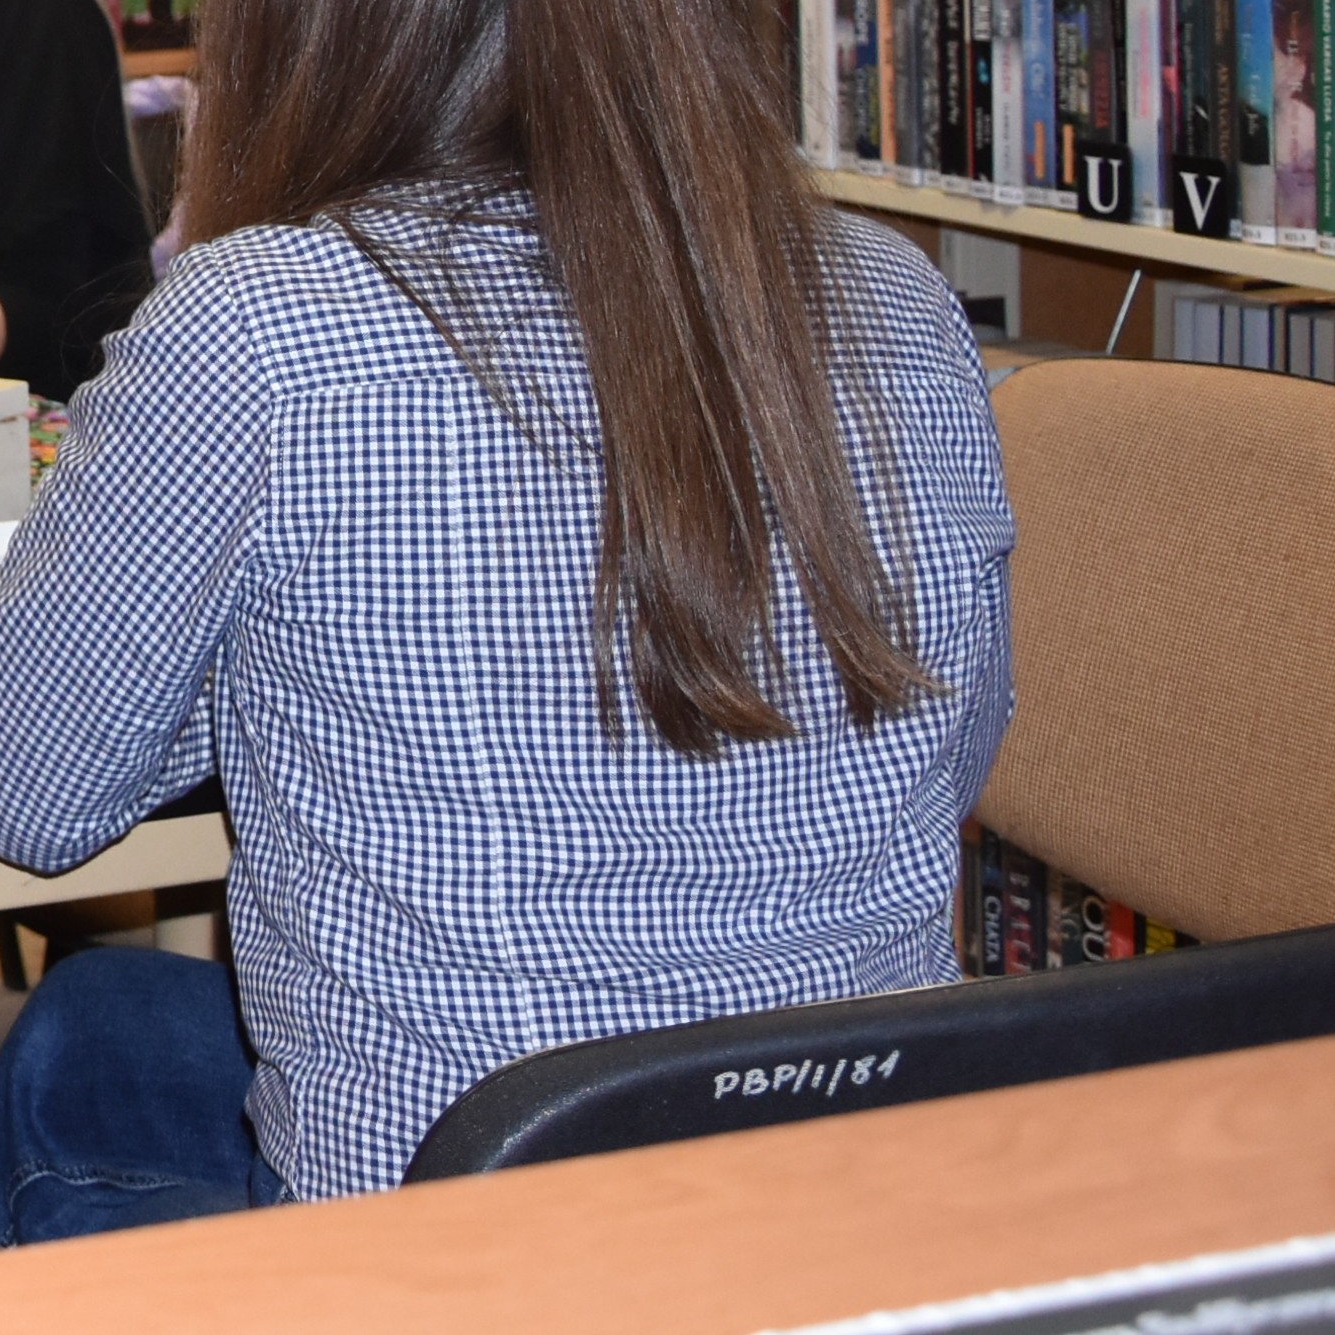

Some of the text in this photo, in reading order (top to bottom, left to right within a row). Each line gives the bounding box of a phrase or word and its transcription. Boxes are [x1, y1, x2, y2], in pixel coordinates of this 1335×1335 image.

[1323, 36, 1332, 83] VARGAS
[1323, 85, 1332, 122] LLOSA
[1084, 155, 1122, 214] U
[1179, 171, 1221, 231] V
[984, 895, 1001, 963] CHATA
